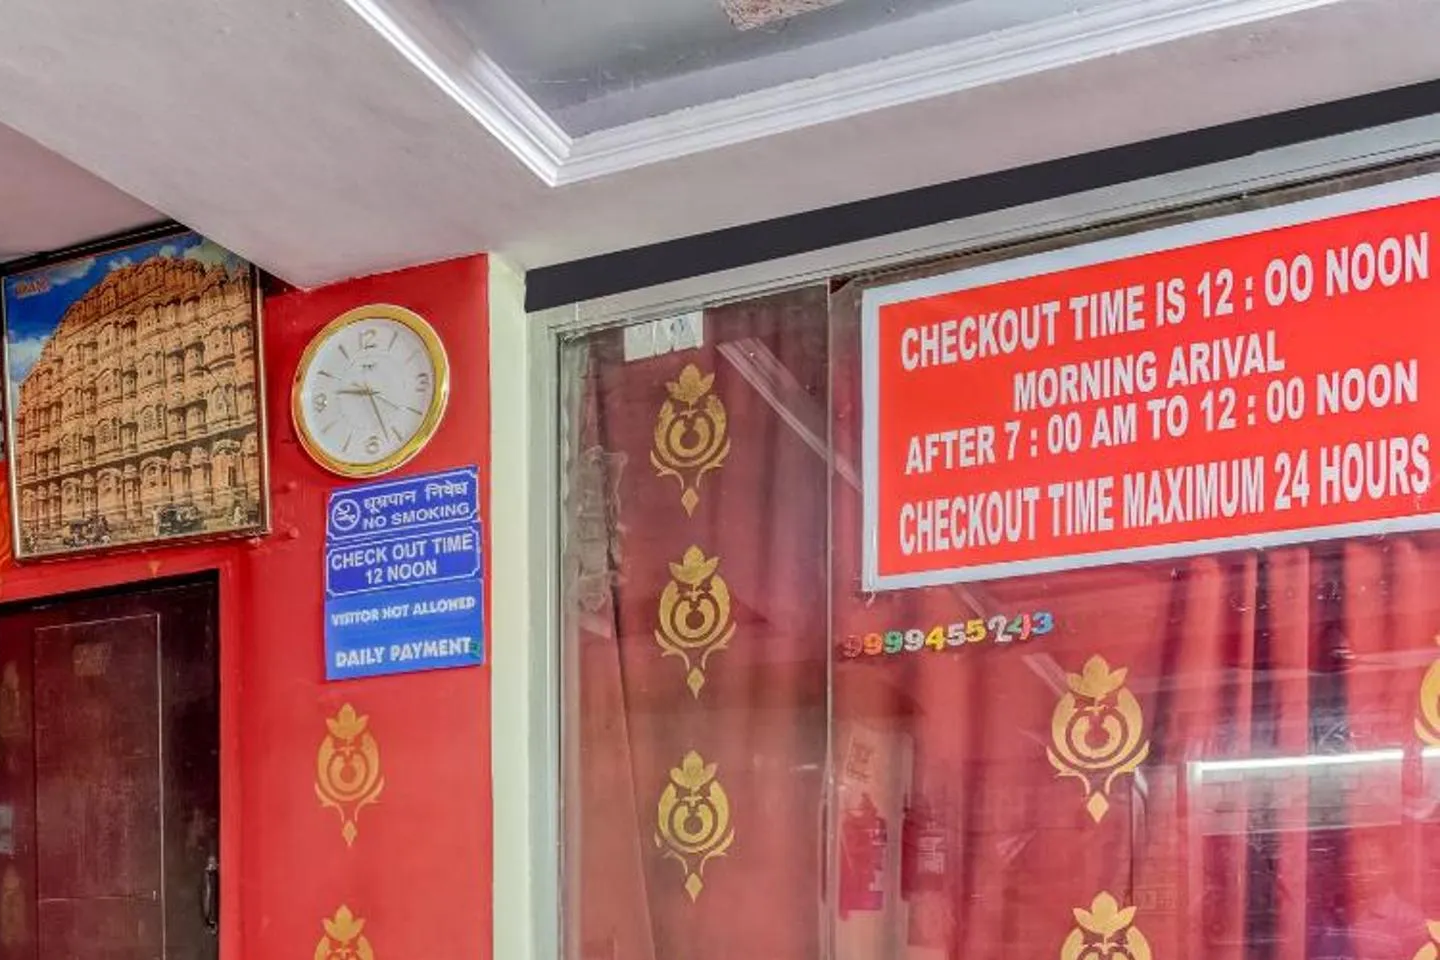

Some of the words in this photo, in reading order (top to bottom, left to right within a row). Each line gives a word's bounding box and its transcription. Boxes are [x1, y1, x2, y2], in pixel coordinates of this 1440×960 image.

[900, 300, 1061, 372] CHECKOUT
[1068, 285, 1145, 341] TIME
[1156, 277, 1186, 327] IS
[1197, 267, 1234, 319] 12
[1325, 232, 1429, 297] NOON
[1013, 351, 1157, 413] MORNING
[1166, 330, 1285, 389] ARIVAL
[905, 425, 996, 475] AFTER
[1004, 420, 1021, 461] 7
[1090, 402, 1137, 449] AM
[1147, 395, 1189, 440] TO
[1200, 387, 1237, 432] 12
[1316, 359, 1419, 415] NOON
[899, 487, 1041, 556] CHECKOUT
[1048, 476, 1114, 538] TIME
[1123, 455, 1265, 528] MAXIMUM
[1274, 448, 1310, 511] 24
[1320, 433, 1431, 505] HOURS
[363, 515, 387, 530] NO
[391, 502, 470, 525] SMOKING
[331, 545, 388, 570] CHECK
[392, 540, 428, 561] OUT
[432, 533, 473, 554] TIME
[365, 568, 383, 584] 12
[388, 560, 437, 581] NOON
[331, 609, 380, 626] VISITOR
[382, 604, 410, 619] NOT
[412, 596, 476, 615] ALLOWED
[335, 646, 387, 668] DAILY
[390, 637, 472, 662] PAYMENT
